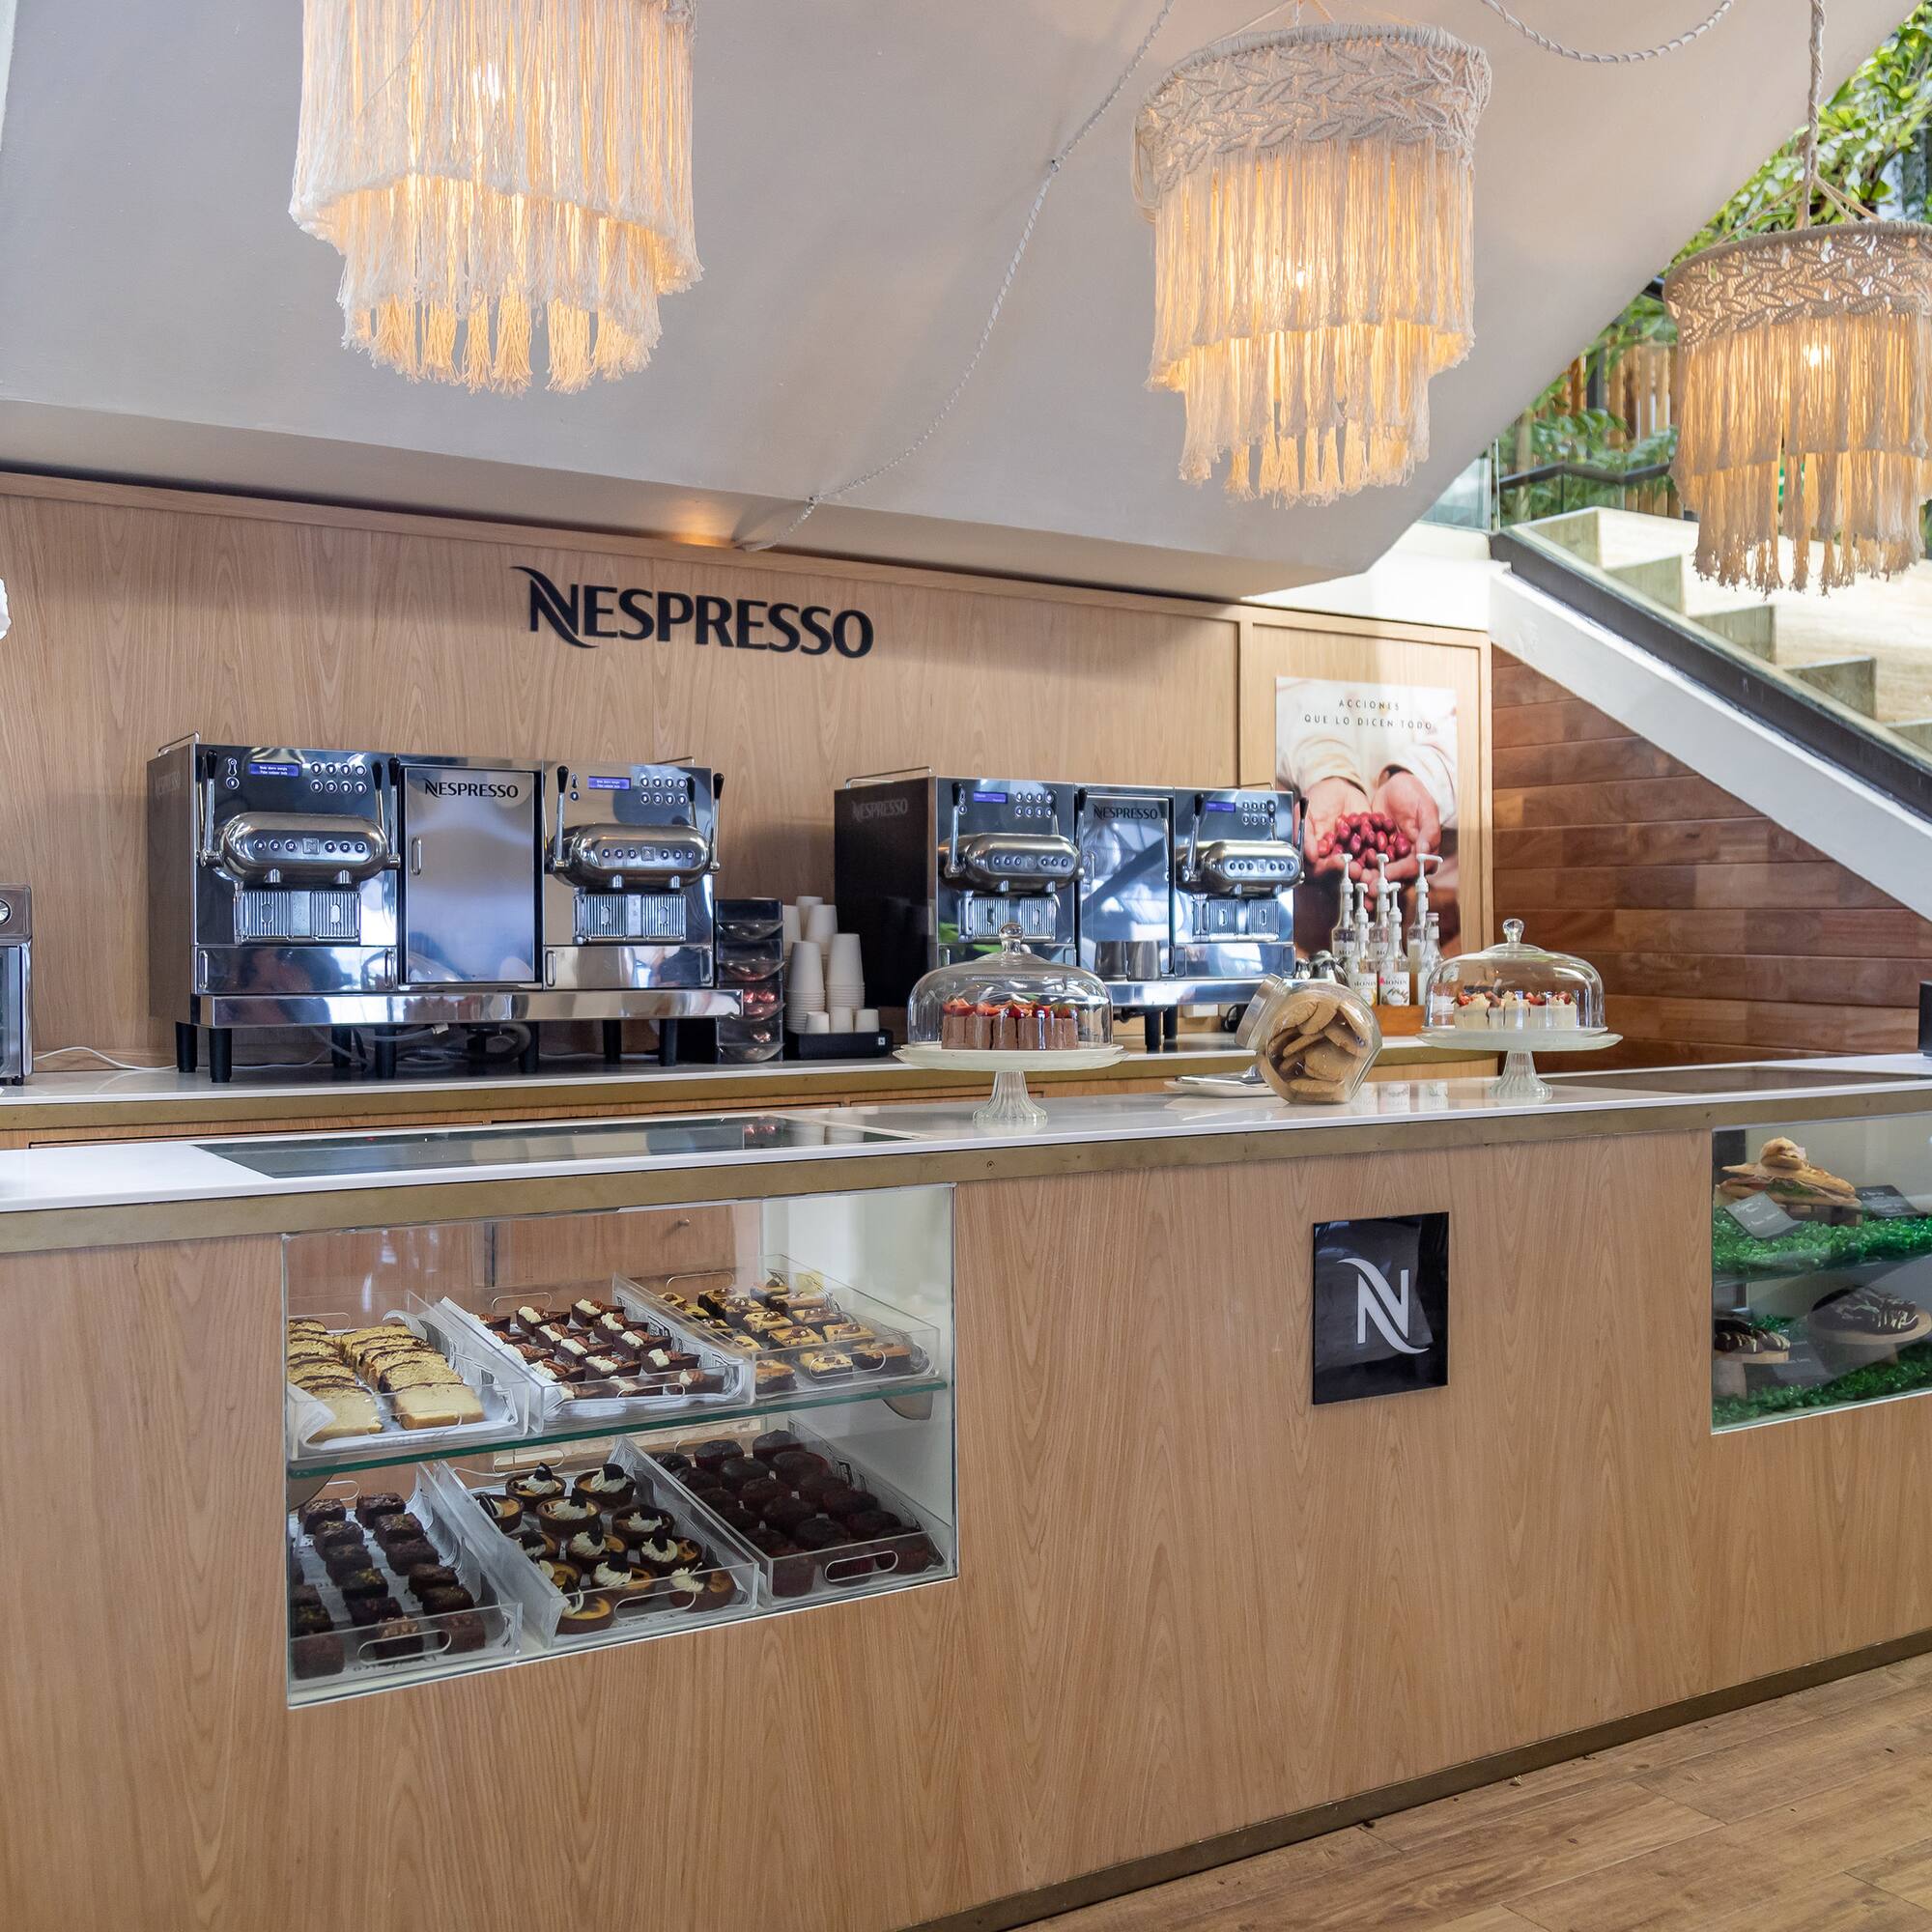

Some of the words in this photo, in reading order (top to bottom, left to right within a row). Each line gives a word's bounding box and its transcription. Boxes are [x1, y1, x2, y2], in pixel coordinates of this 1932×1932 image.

[510, 566, 874, 659] NESPRESSO
[1338, 698, 1400, 711] ACCIONES
[1304, 714, 1328, 724] QUE
[1335, 716, 1350, 725] LO
[1357, 717, 1394, 727] DICEN
[1401, 719, 1433, 730] TODO
[421, 778, 519, 798] NESPRESSO
[851, 797, 909, 823] NESPRESSO
[1092, 803, 1158, 820] NESPRESSO
[1337, 1258, 1430, 1354] N
